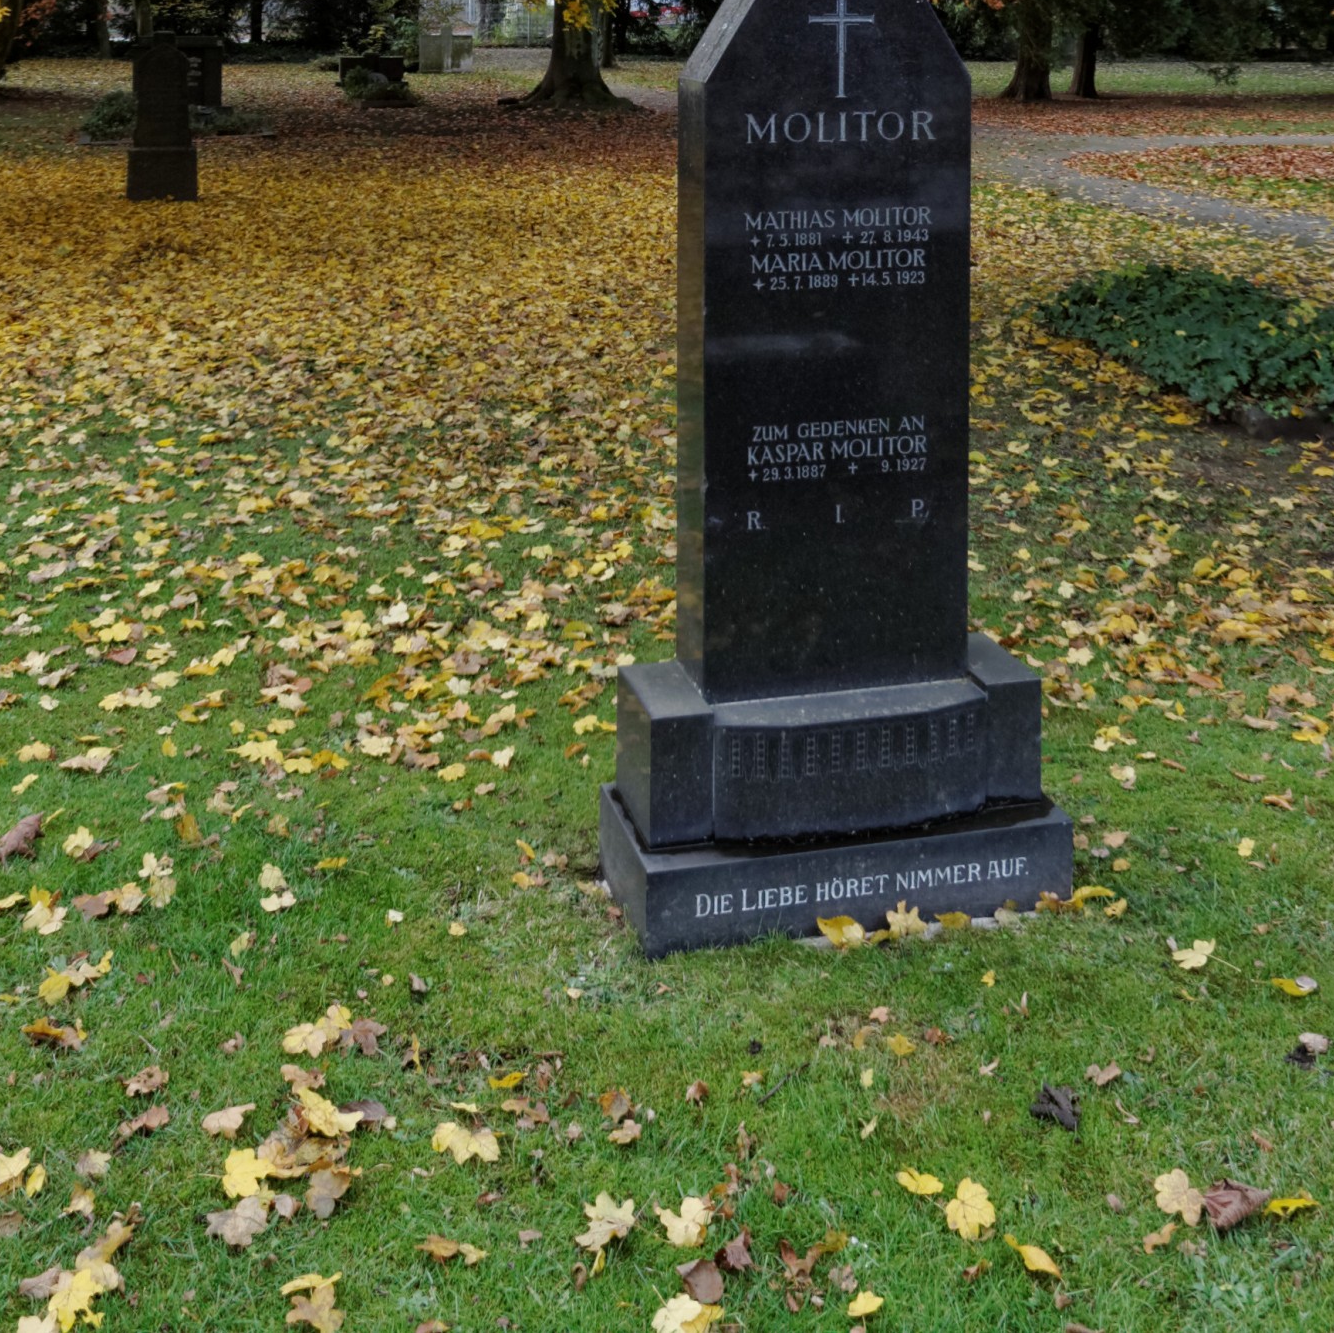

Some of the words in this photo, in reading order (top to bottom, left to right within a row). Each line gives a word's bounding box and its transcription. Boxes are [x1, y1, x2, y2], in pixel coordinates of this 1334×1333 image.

[744, 110, 937, 144] MOLITOR
[743, 209, 835, 231] MATHIAS
[842, 206, 933, 227] MOLITOR
[750, 252, 824, 274] MARIA
[827, 248, 926, 270] MOLITOR
[752, 424, 789, 443] ZUM
[797, 417, 890, 439] GEDENKEN
[899, 414, 925, 432] AN
[747, 442, 825, 466] KASPAR
[831, 435, 928, 460] MOLITOR
[695, 893, 733, 918] DIE
[741, 884, 809, 912] LIEBE
[816, 874, 890, 903] HÖRET
[896, 861, 981, 892] NIMMER
[986, 856, 1030, 879] AUF.
